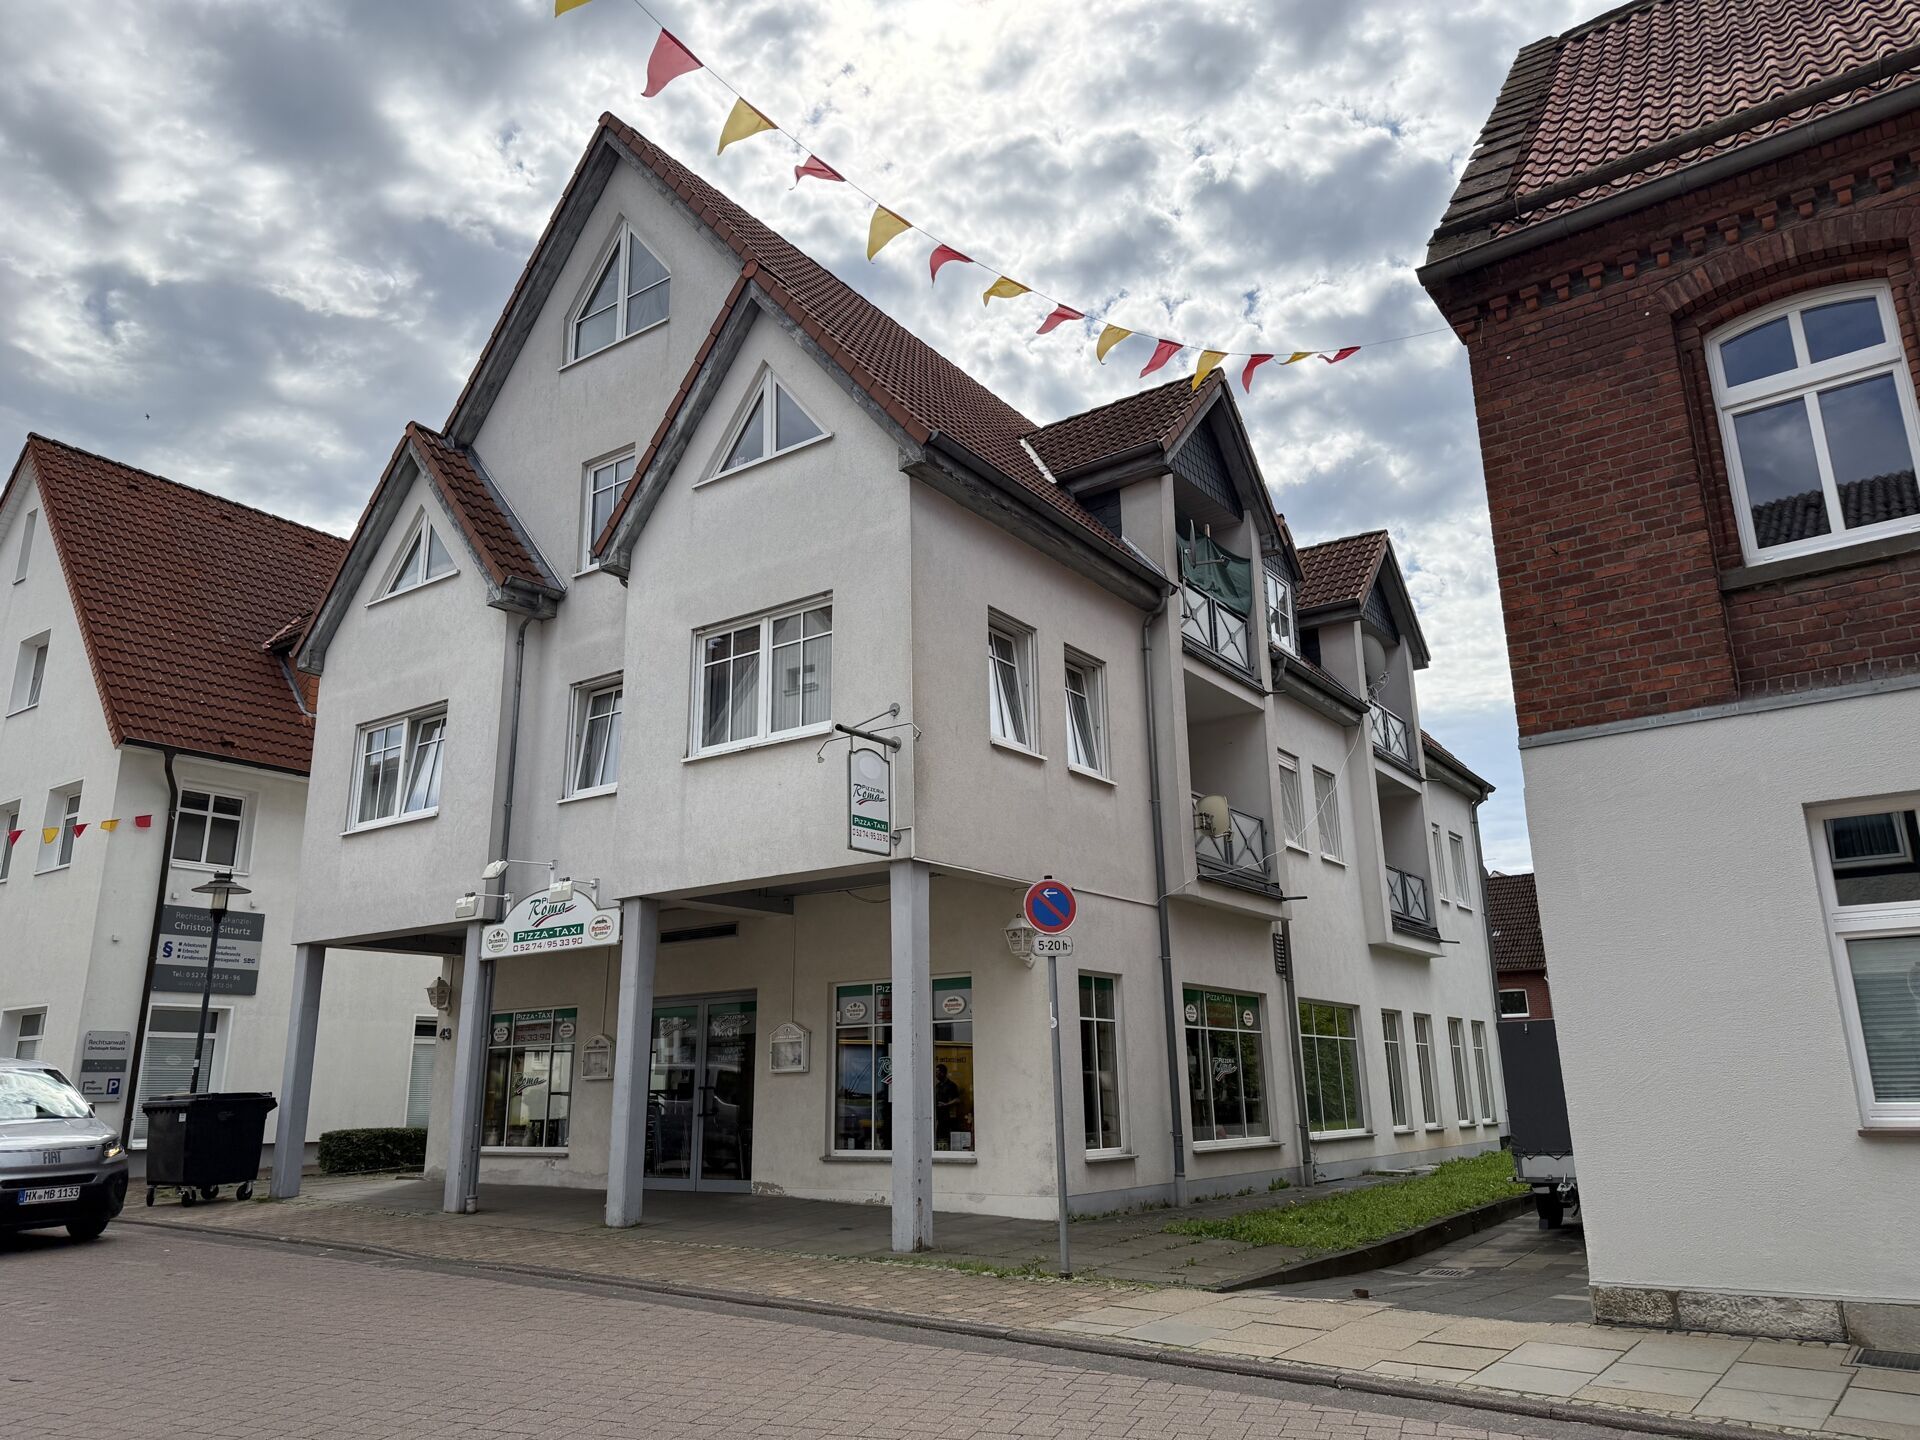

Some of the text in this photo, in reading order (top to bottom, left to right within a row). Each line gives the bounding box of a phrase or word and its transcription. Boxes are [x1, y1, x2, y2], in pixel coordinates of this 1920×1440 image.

[853, 784, 881, 801] Roma
[528, 899, 567, 920] Roma
[1038, 940, 1068, 951] 5-20 h
[440, 1028, 452, 1040] 43
[42, 1150, 61, 1165] FIAT
[24, 1187, 80, 1203] HX MB 1133
